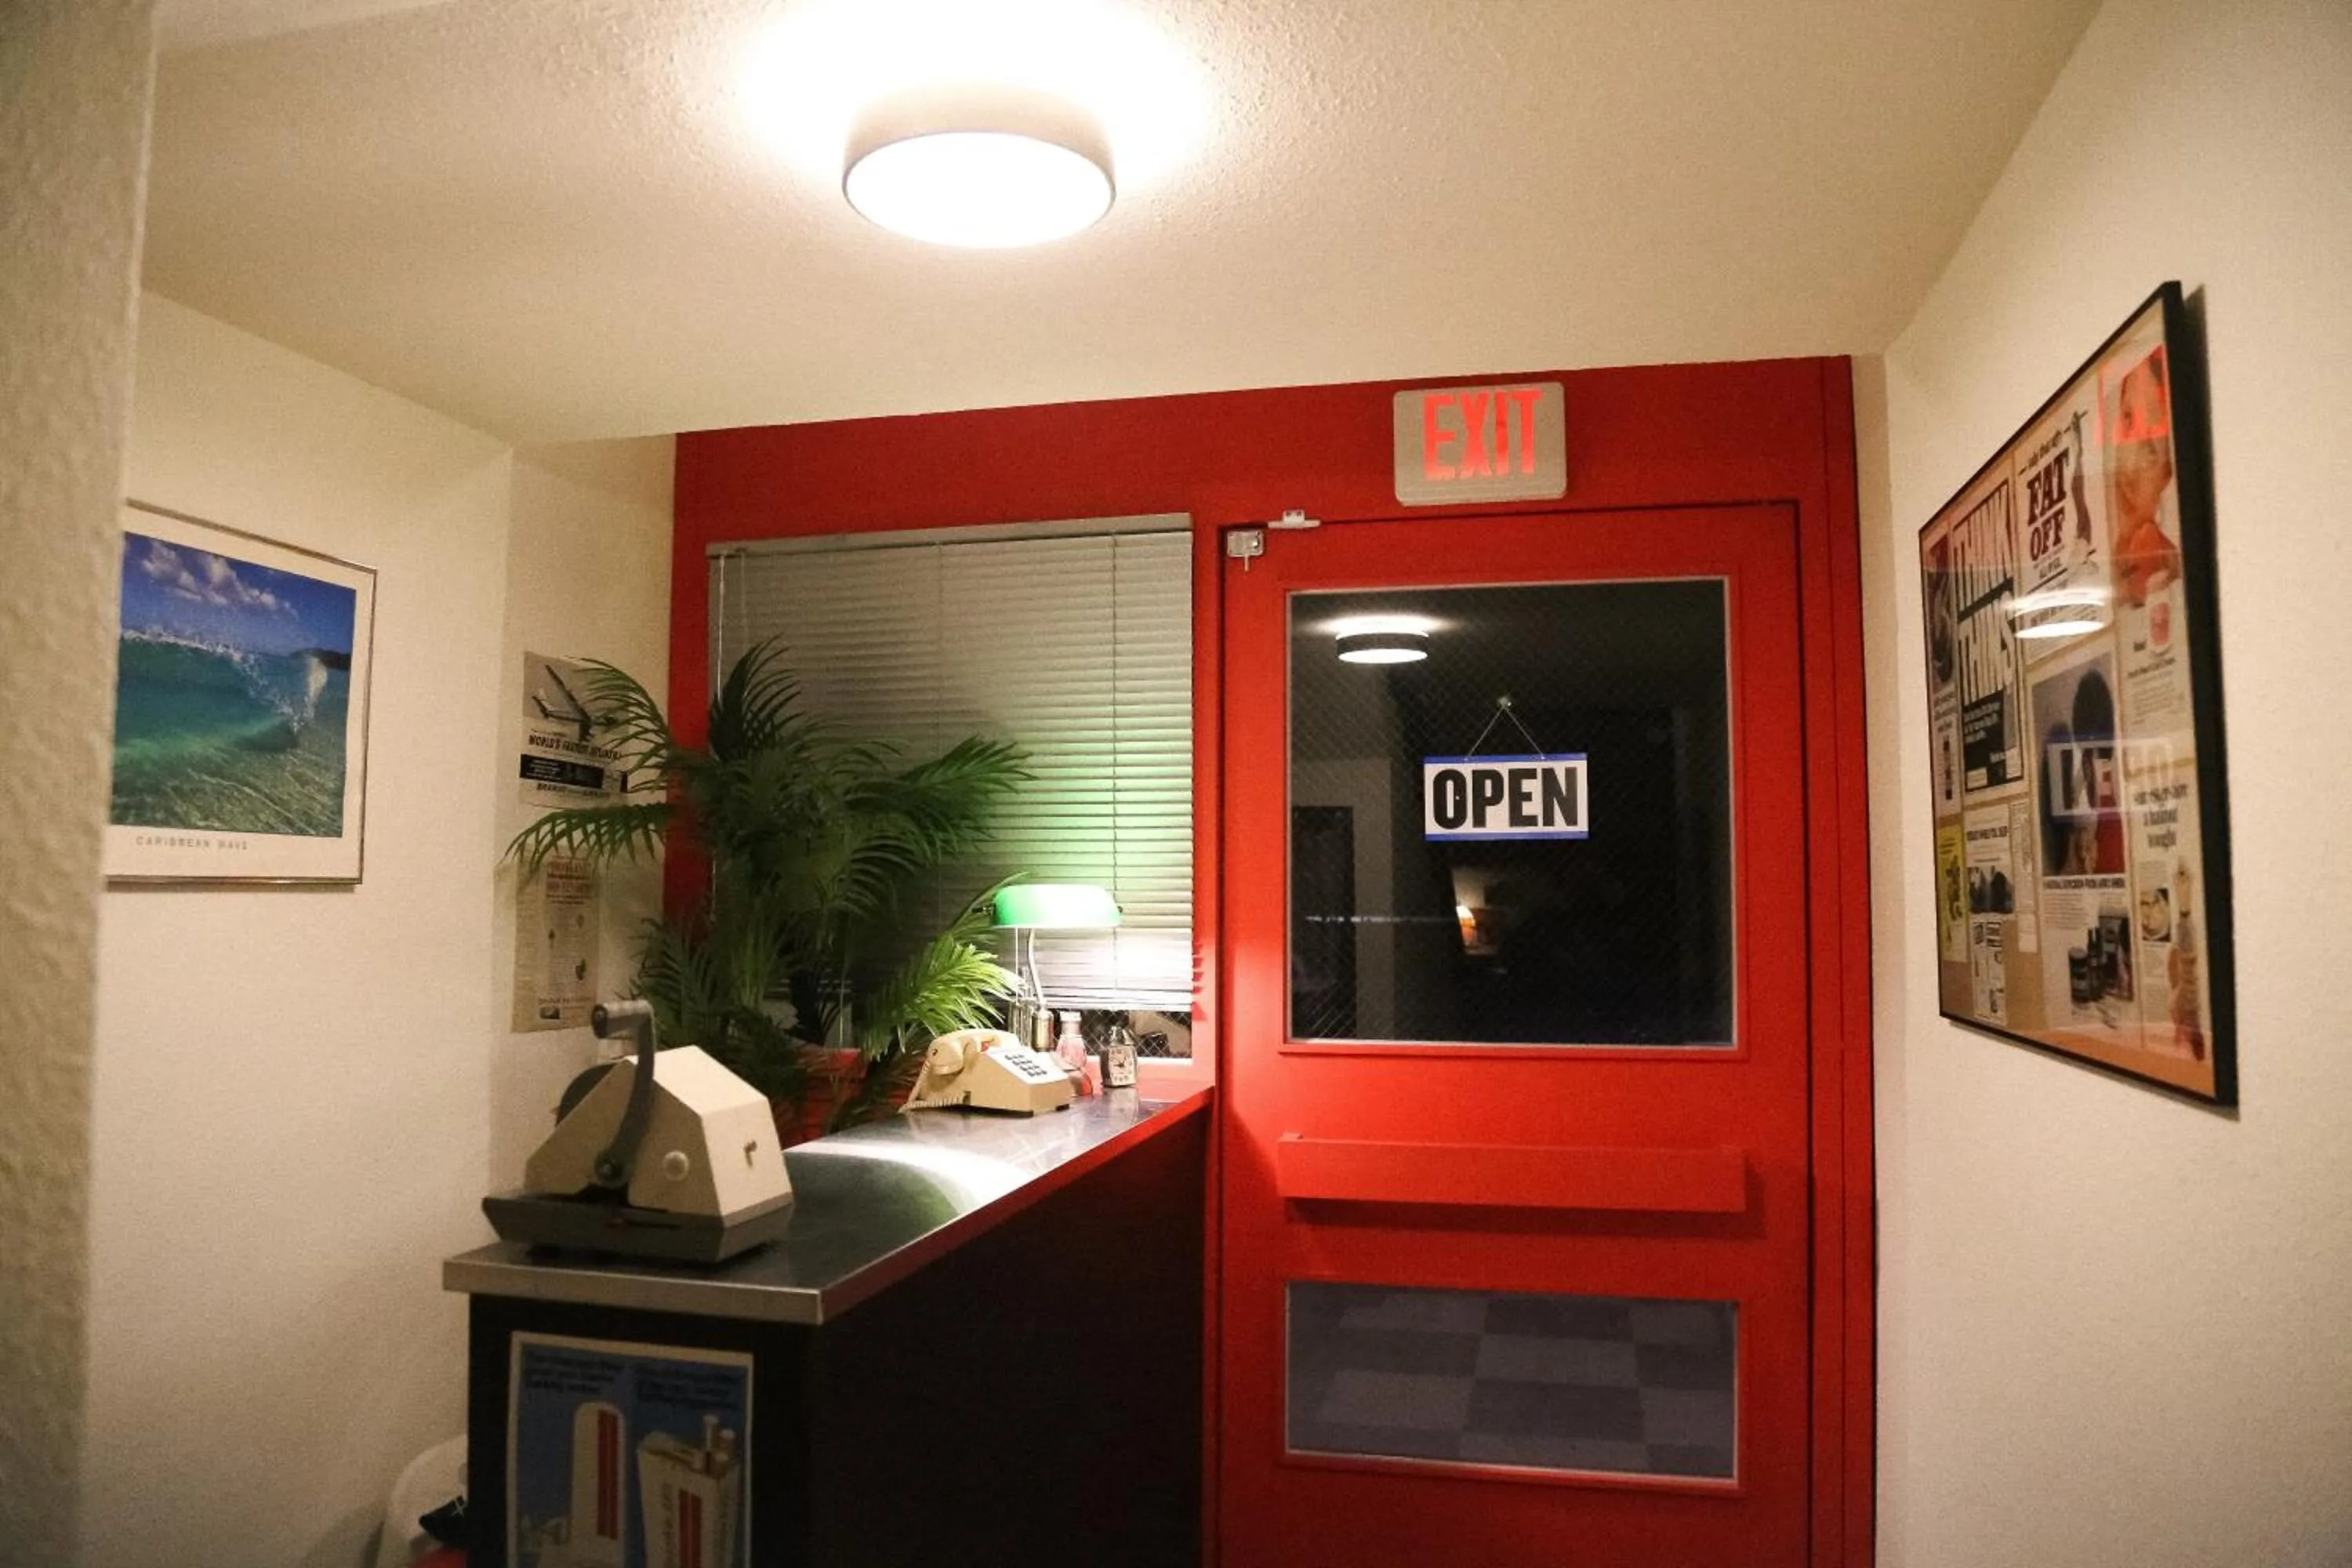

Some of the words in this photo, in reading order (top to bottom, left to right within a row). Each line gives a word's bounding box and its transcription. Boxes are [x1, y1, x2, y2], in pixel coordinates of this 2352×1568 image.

[1423, 387, 1542, 481] EXIT
[2026, 447, 2071, 527] FAT
[2030, 506, 2066, 562] OFF
[1432, 766, 1579, 830] OPEN
[136, 836, 210, 849] CARIBBEAN
